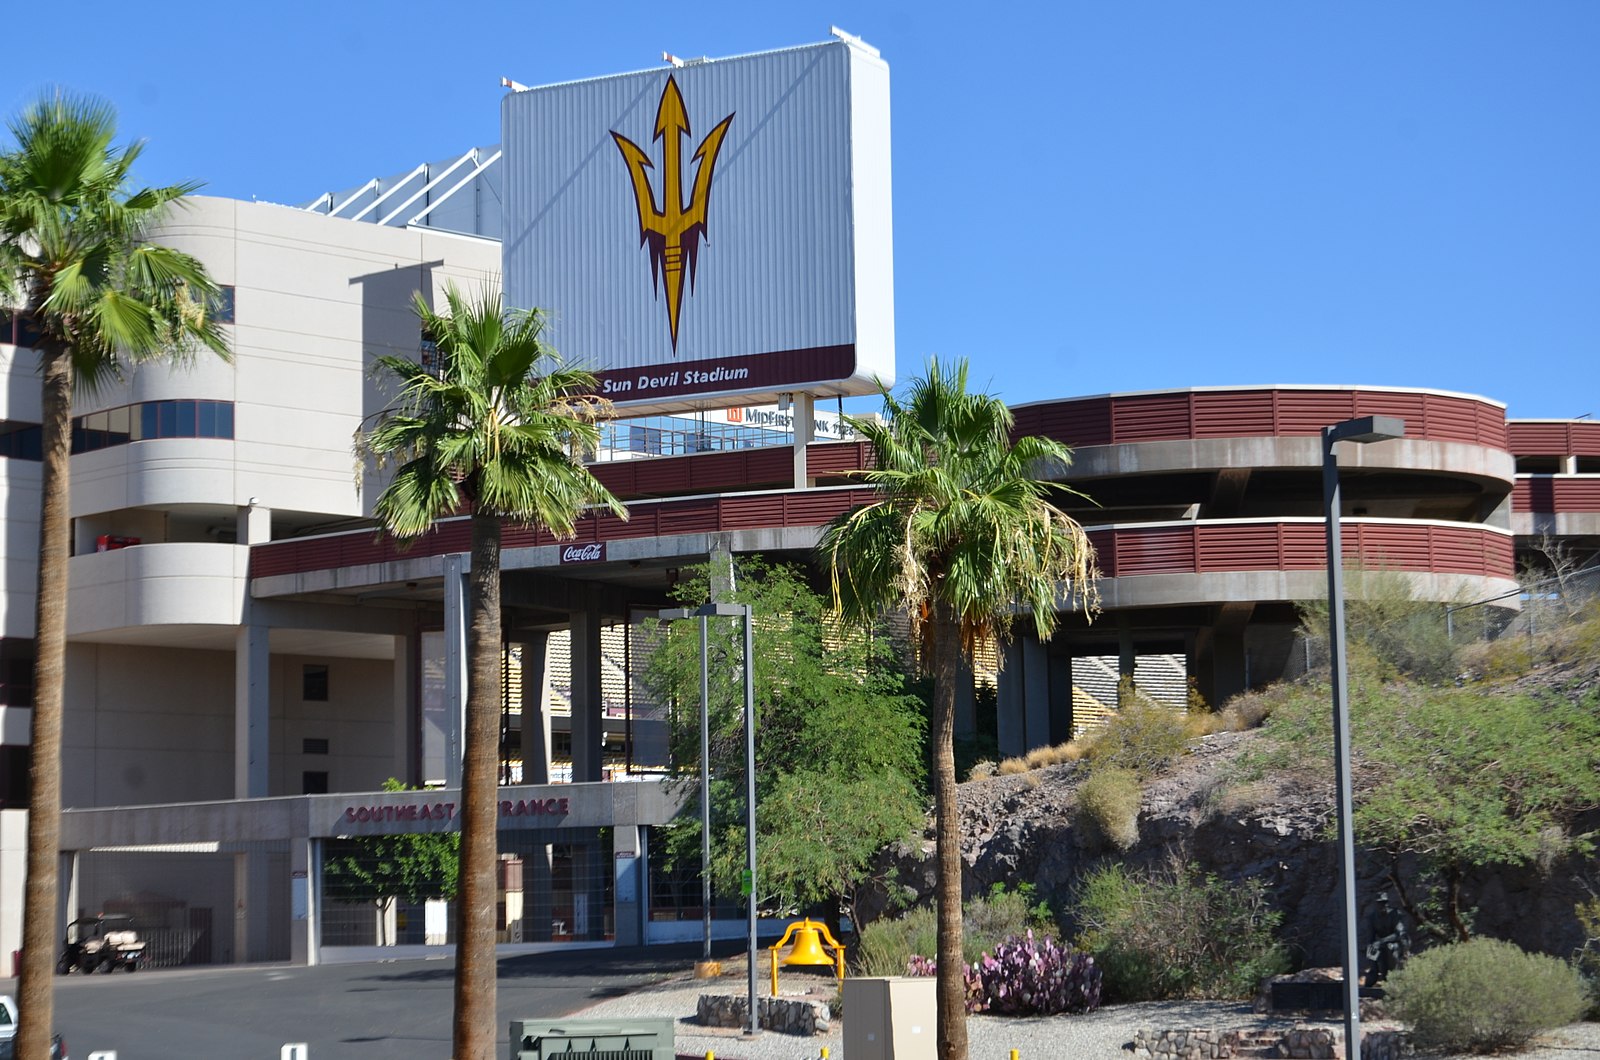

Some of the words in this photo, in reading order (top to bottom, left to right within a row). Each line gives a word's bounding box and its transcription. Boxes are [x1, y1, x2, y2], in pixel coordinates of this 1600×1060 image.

[602, 379, 632, 393] Sun
[637, 371, 679, 390] Devil
[683, 366, 749, 385] Stadium
[563, 543, 603, 562] Coca-Cola
[345, 803, 455, 823] SOUTHEAST
[497, 798, 569, 816] RANCE
